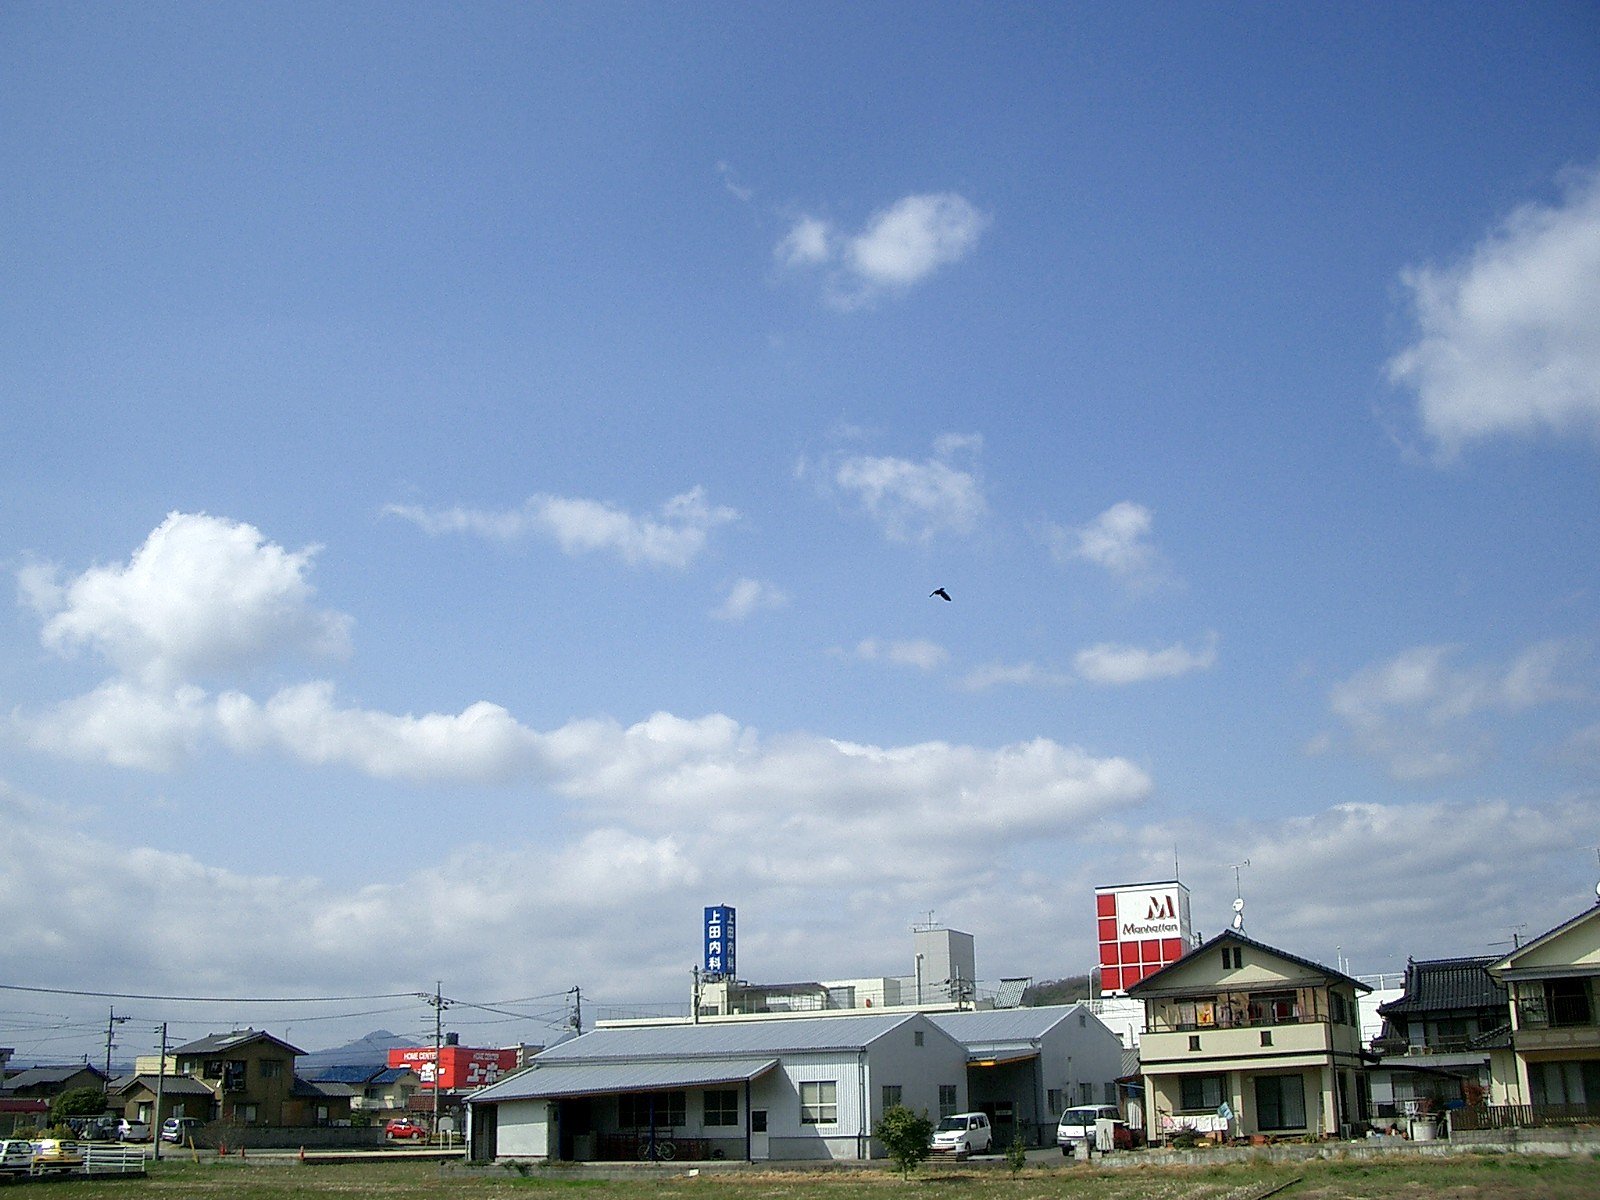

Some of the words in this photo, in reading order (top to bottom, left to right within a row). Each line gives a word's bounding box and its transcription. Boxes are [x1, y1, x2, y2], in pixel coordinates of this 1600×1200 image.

[1122, 923, 1179, 935] Manhattan
[708, 910, 722, 971] 上田内科
[403, 1052, 418, 1060] HOME
